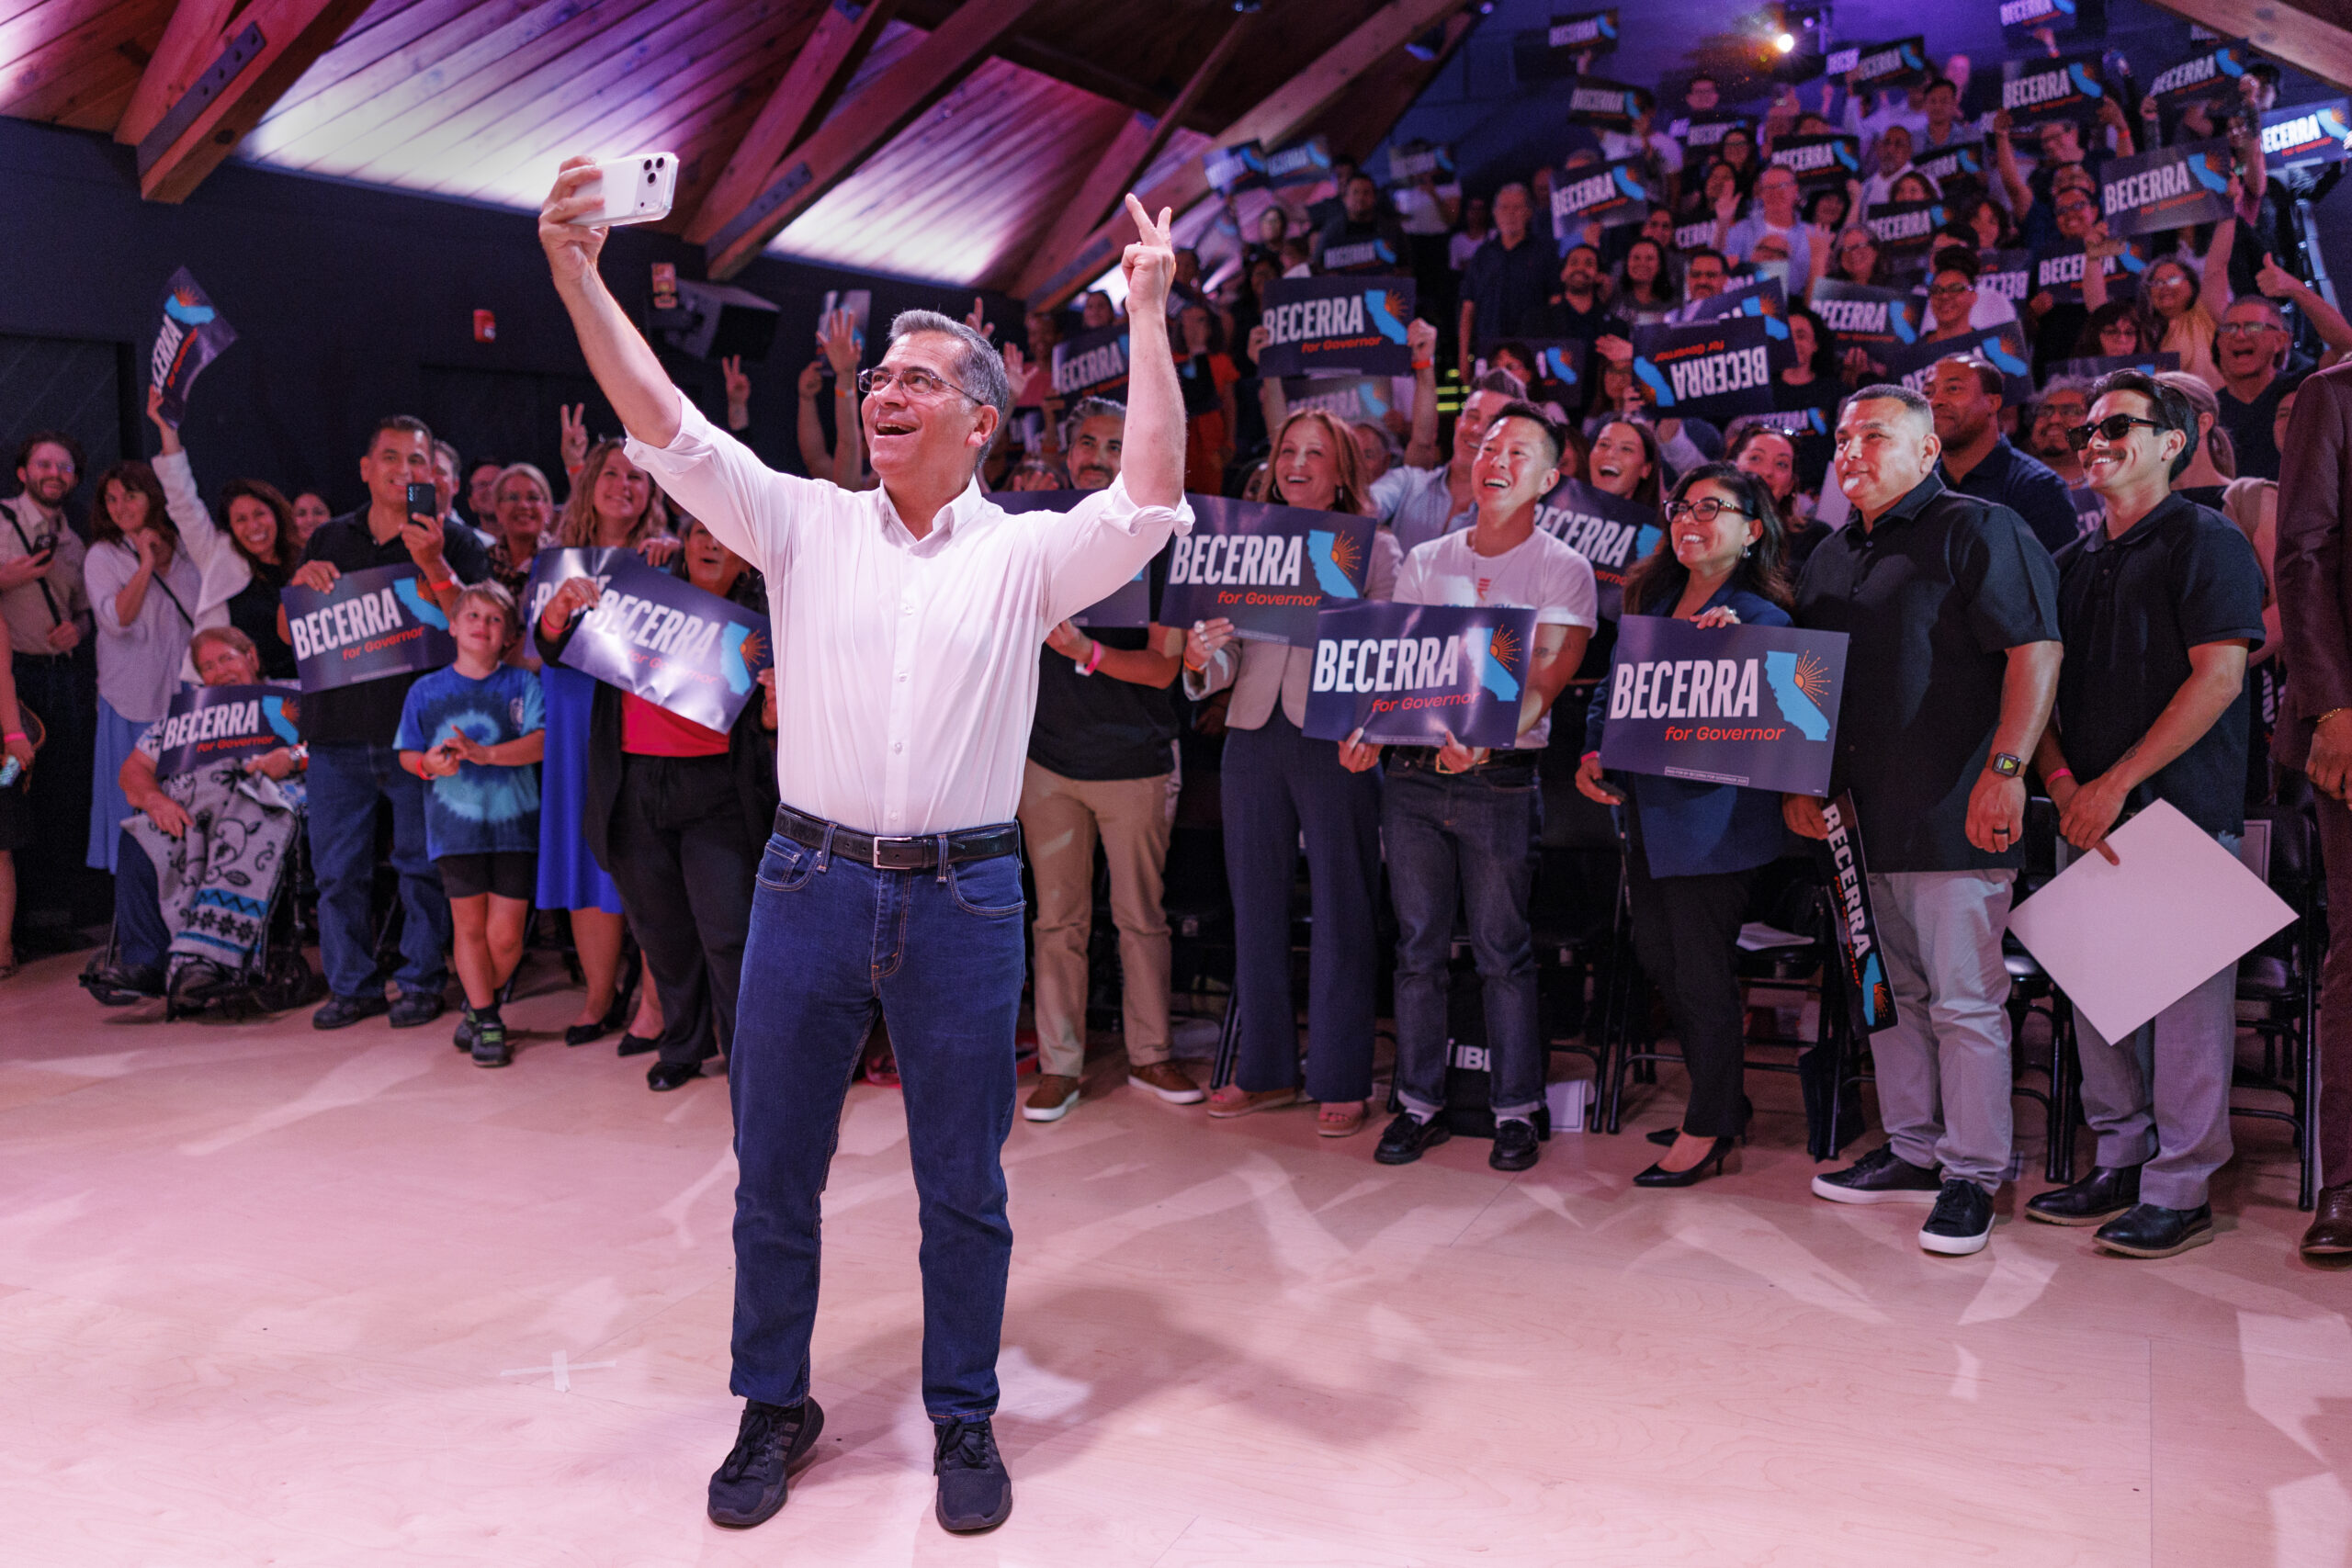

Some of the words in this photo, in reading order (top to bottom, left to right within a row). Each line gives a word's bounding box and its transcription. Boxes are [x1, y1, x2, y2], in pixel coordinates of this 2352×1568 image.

[2261, 114, 2322, 154] ECERRA
[2105, 161, 2190, 216] BECERRA
[1262, 295, 1364, 344] BECERRA
[1669, 345, 1770, 401] BECERRA
[1169, 534, 1303, 586] BECERRA
[1217, 591, 1243, 605] for
[1246, 592, 1321, 606] Governor
[290, 589, 403, 661] BECERRA
[343, 643, 362, 661] for
[365, 626, 424, 653] Governor
[1313, 635, 1460, 693] BECERRA
[1610, 659, 1758, 719] BECERRA
[163, 699, 259, 752] BECERRA
[1372, 698, 1398, 714] for
[1401, 691, 1480, 710] Governor
[197, 739, 216, 753] for
[218, 735, 275, 750] Governor
[1665, 727, 1692, 740] for
[1697, 727, 1785, 740] Governor
[1823, 803, 1871, 959] BECERRA
